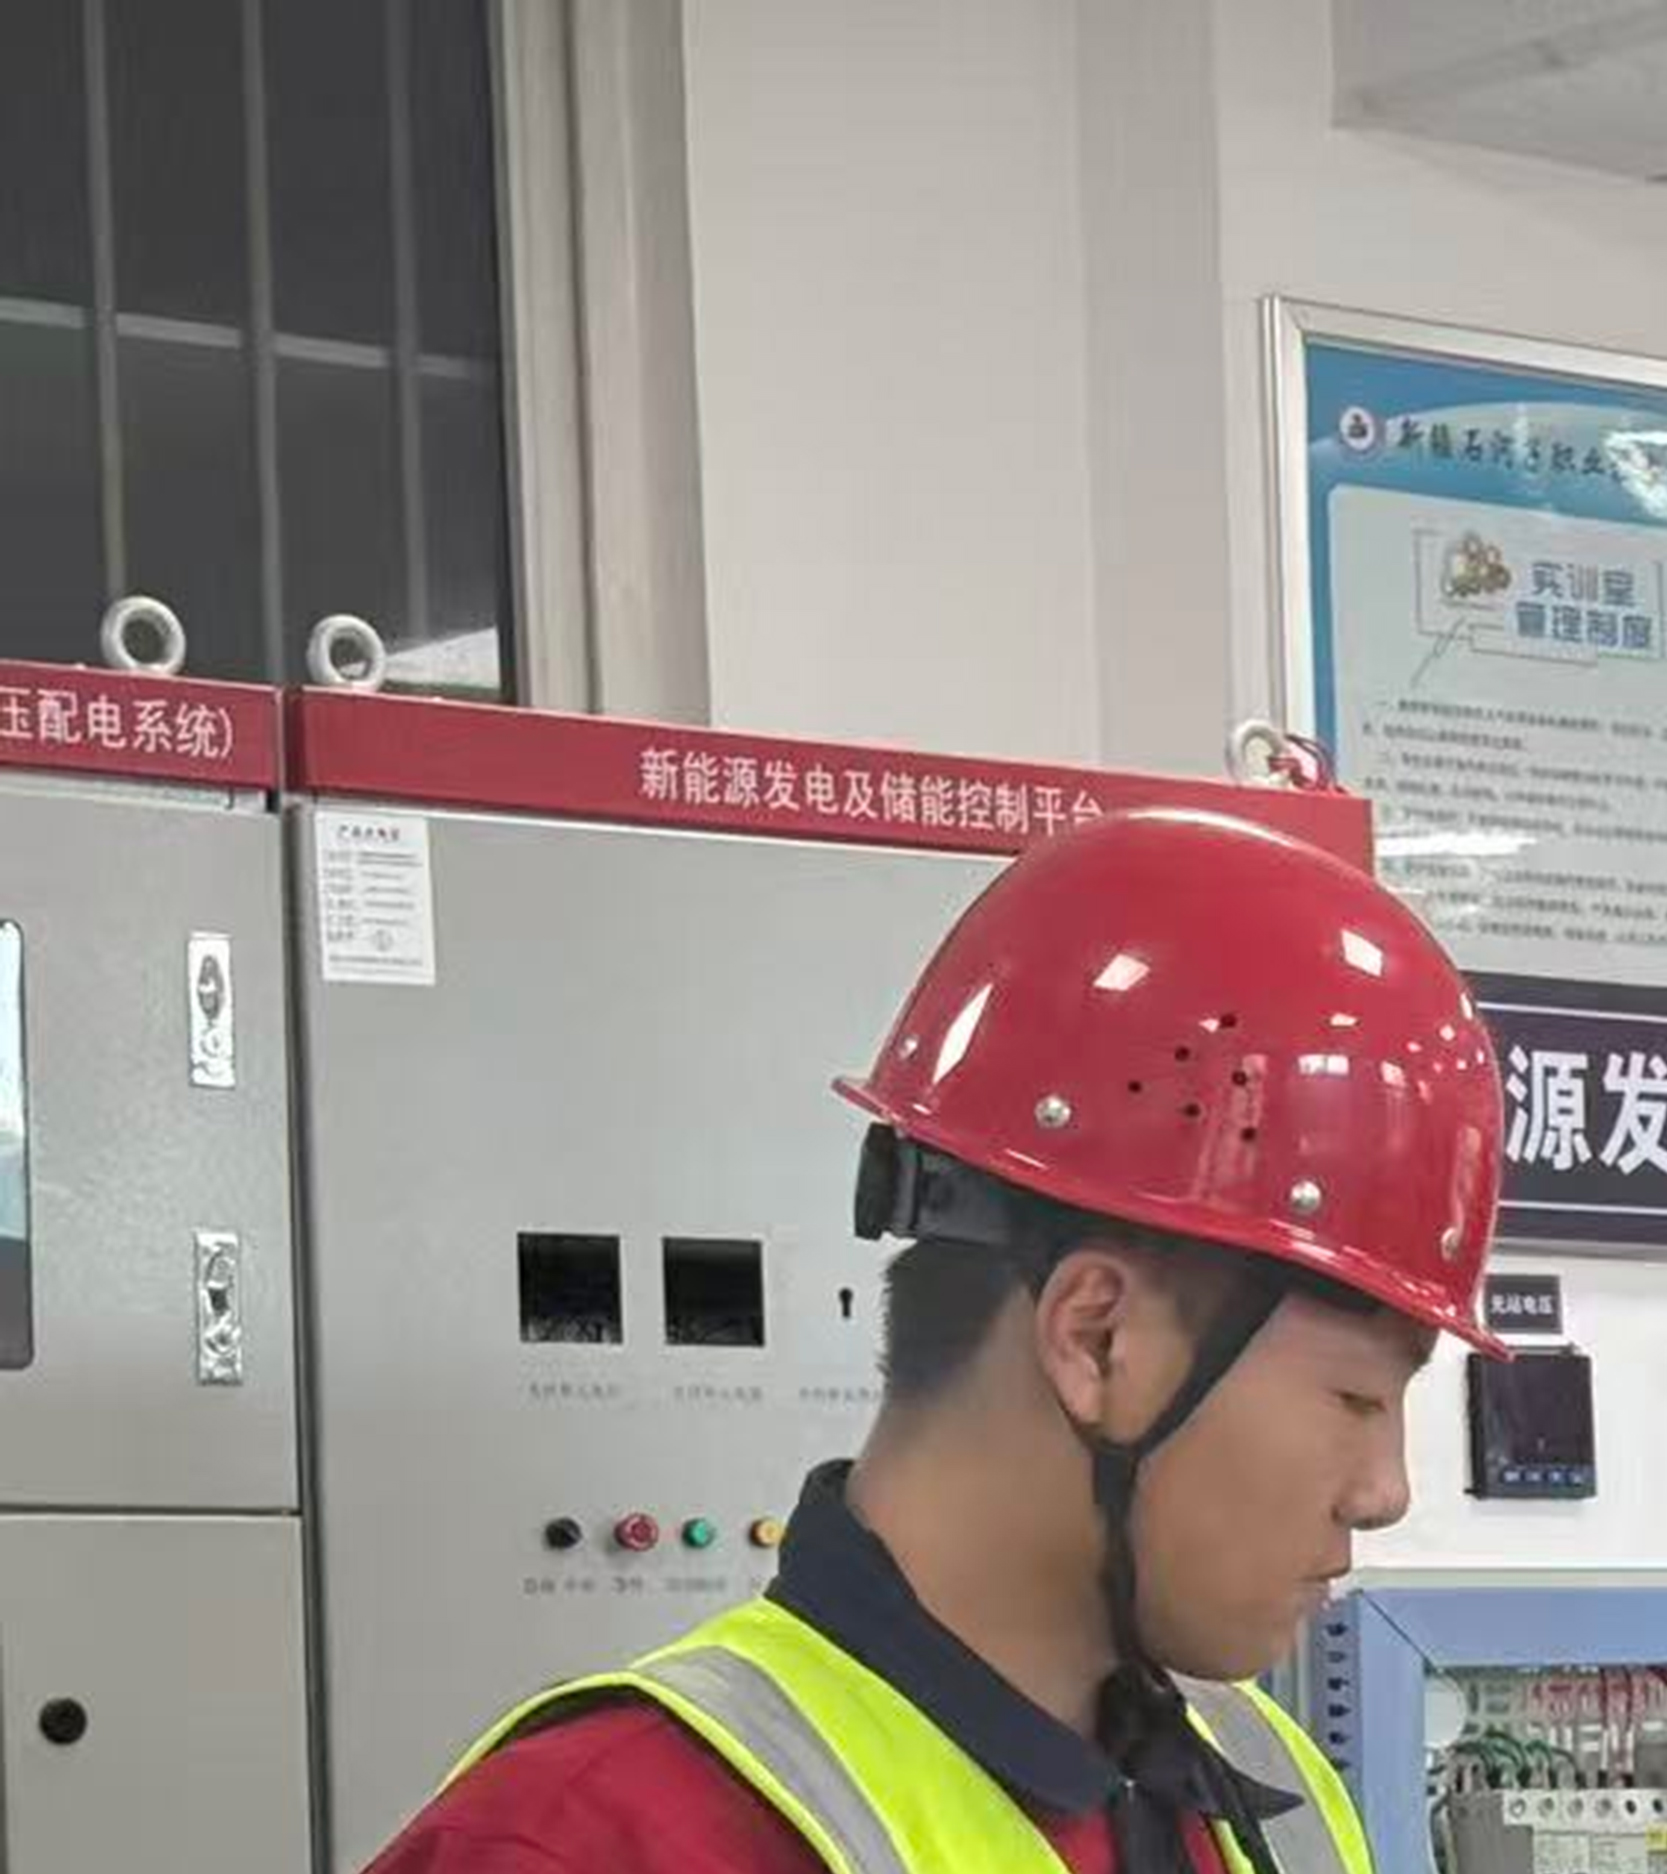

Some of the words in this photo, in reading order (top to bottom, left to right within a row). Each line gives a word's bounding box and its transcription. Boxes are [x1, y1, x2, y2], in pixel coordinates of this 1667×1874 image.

[639, 748, 1105, 838] 新能源发电及储能控制平台
